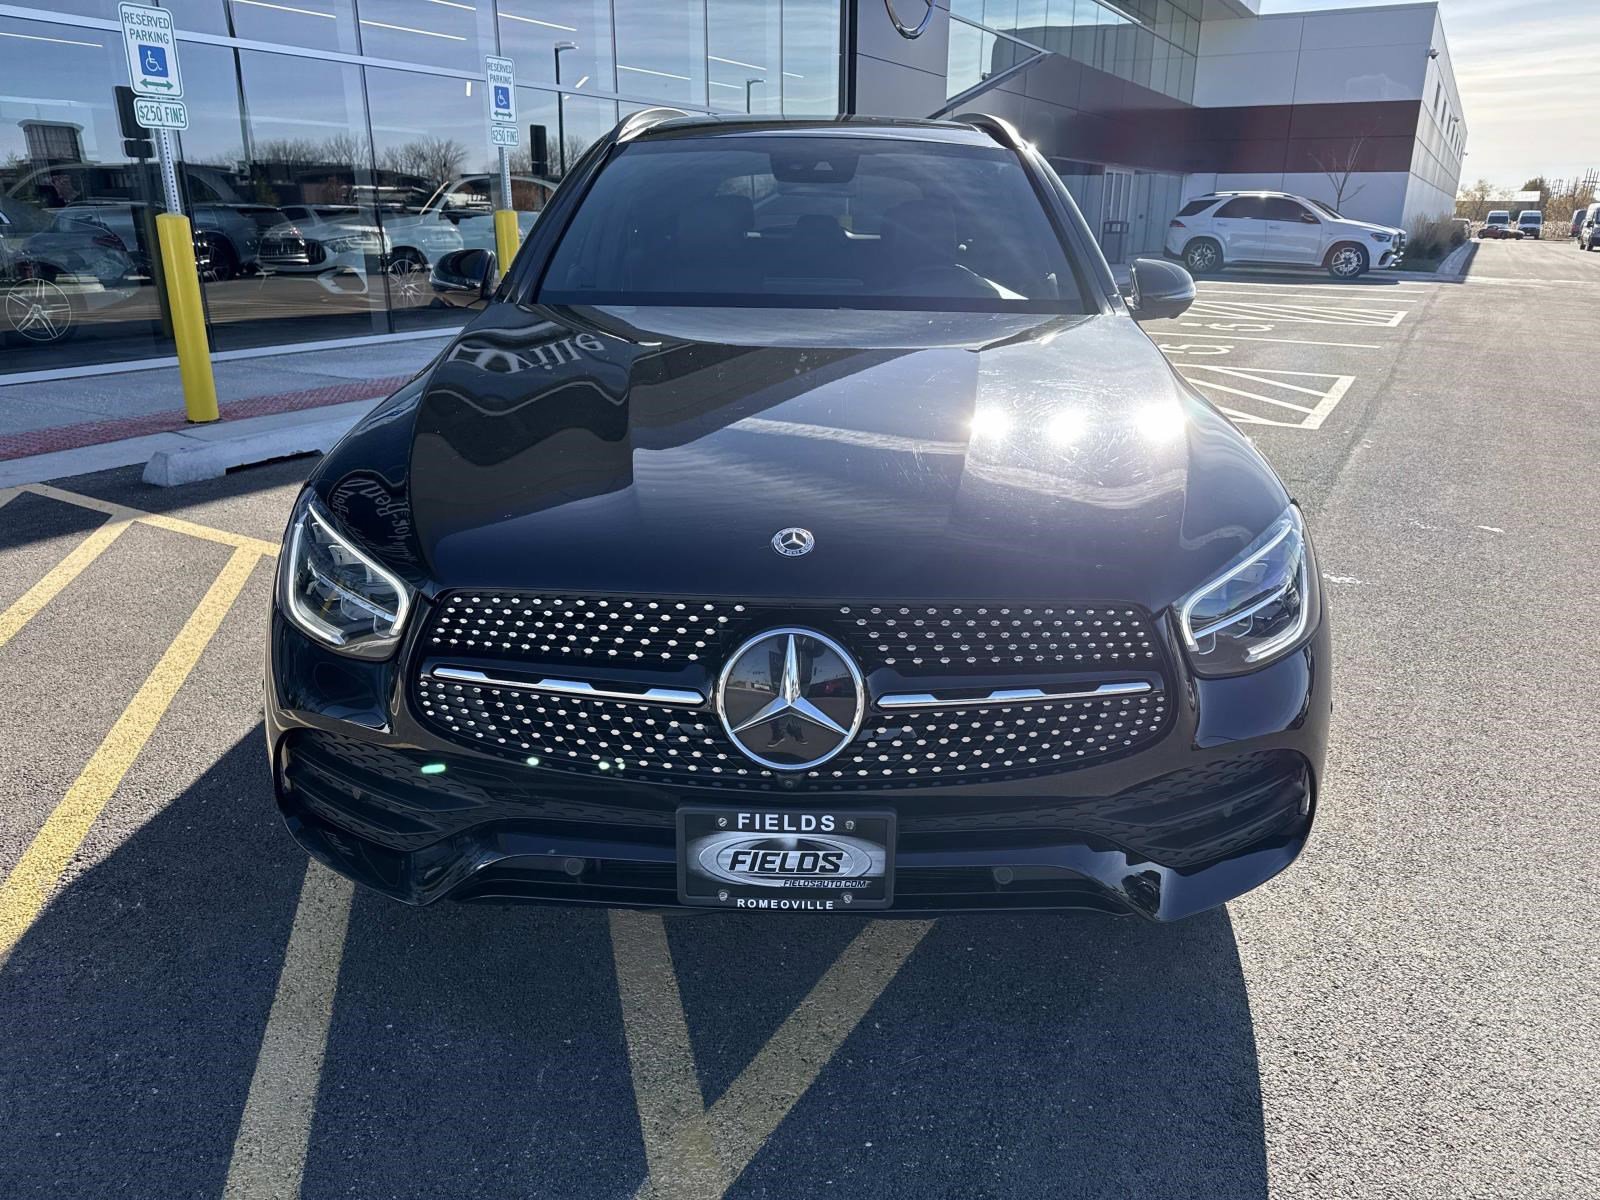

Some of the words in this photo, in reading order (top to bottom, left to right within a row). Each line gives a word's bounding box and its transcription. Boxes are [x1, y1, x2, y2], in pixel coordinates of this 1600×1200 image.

[123, 12, 170, 29] RESERVED
[129, 28, 169, 44] PARKING
[487, 62, 512, 74] RESERVED
[489, 73, 511, 85] PARKING
[139, 105, 162, 122] $250
[164, 106, 185, 123] FINE
[737, 813, 835, 832] FIELDS
[728, 850, 844, 873] FIELDS
[736, 899, 834, 910] ROMEOVILLE
